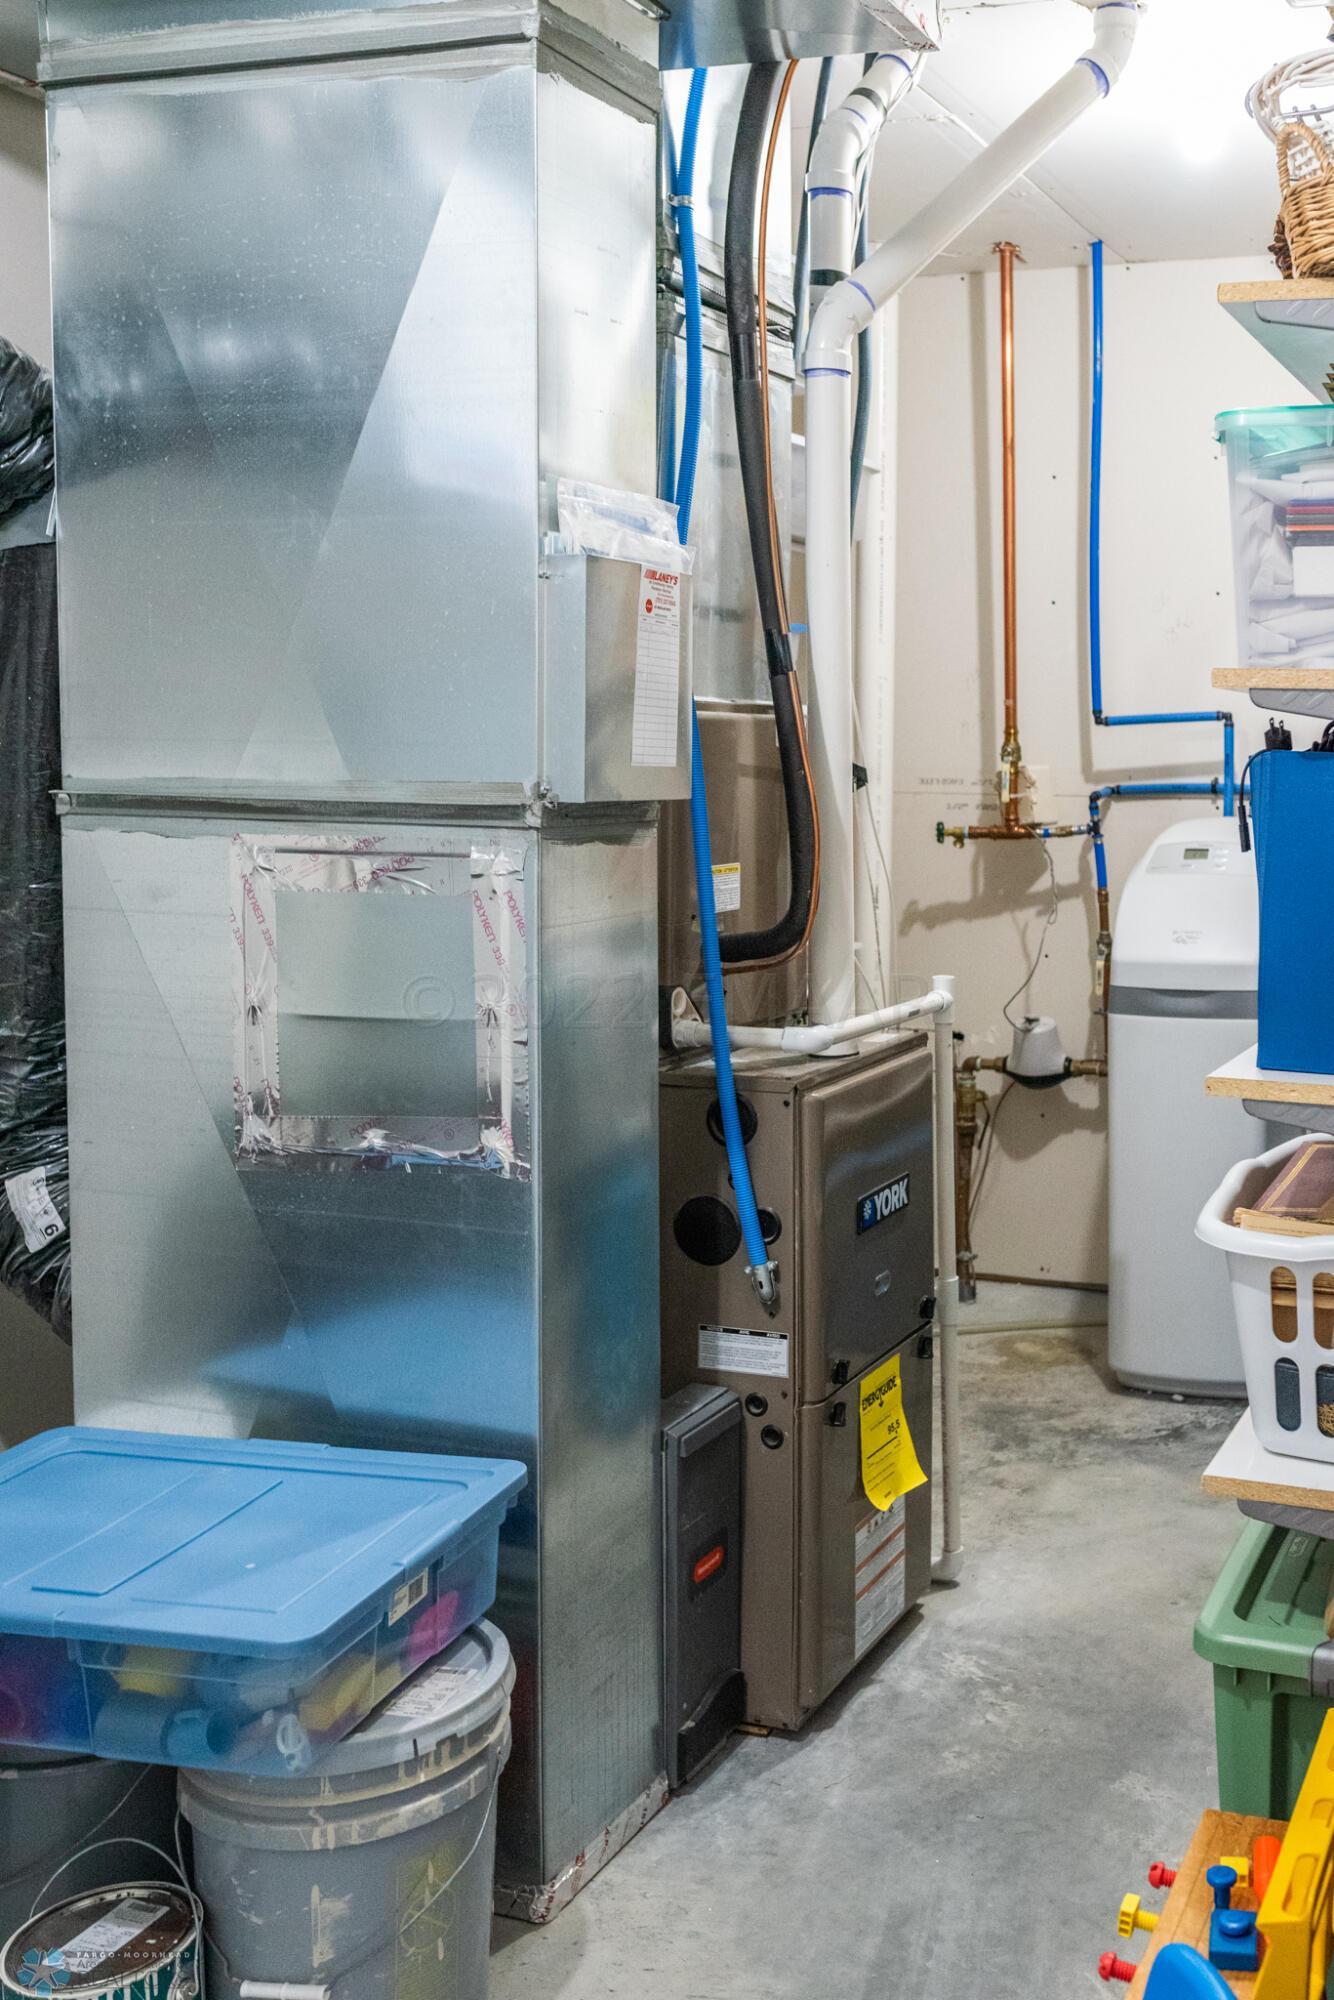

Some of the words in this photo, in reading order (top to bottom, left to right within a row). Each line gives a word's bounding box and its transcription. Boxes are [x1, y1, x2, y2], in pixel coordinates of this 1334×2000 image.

[472, 889, 497, 943] POLYKEN
[503, 889, 526, 944] POLYKE
[873, 1178, 909, 1221] YORK
[862, 1375, 898, 1412] ENERGYGUIDE
[887, 1418, 901, 1436] 95.5
